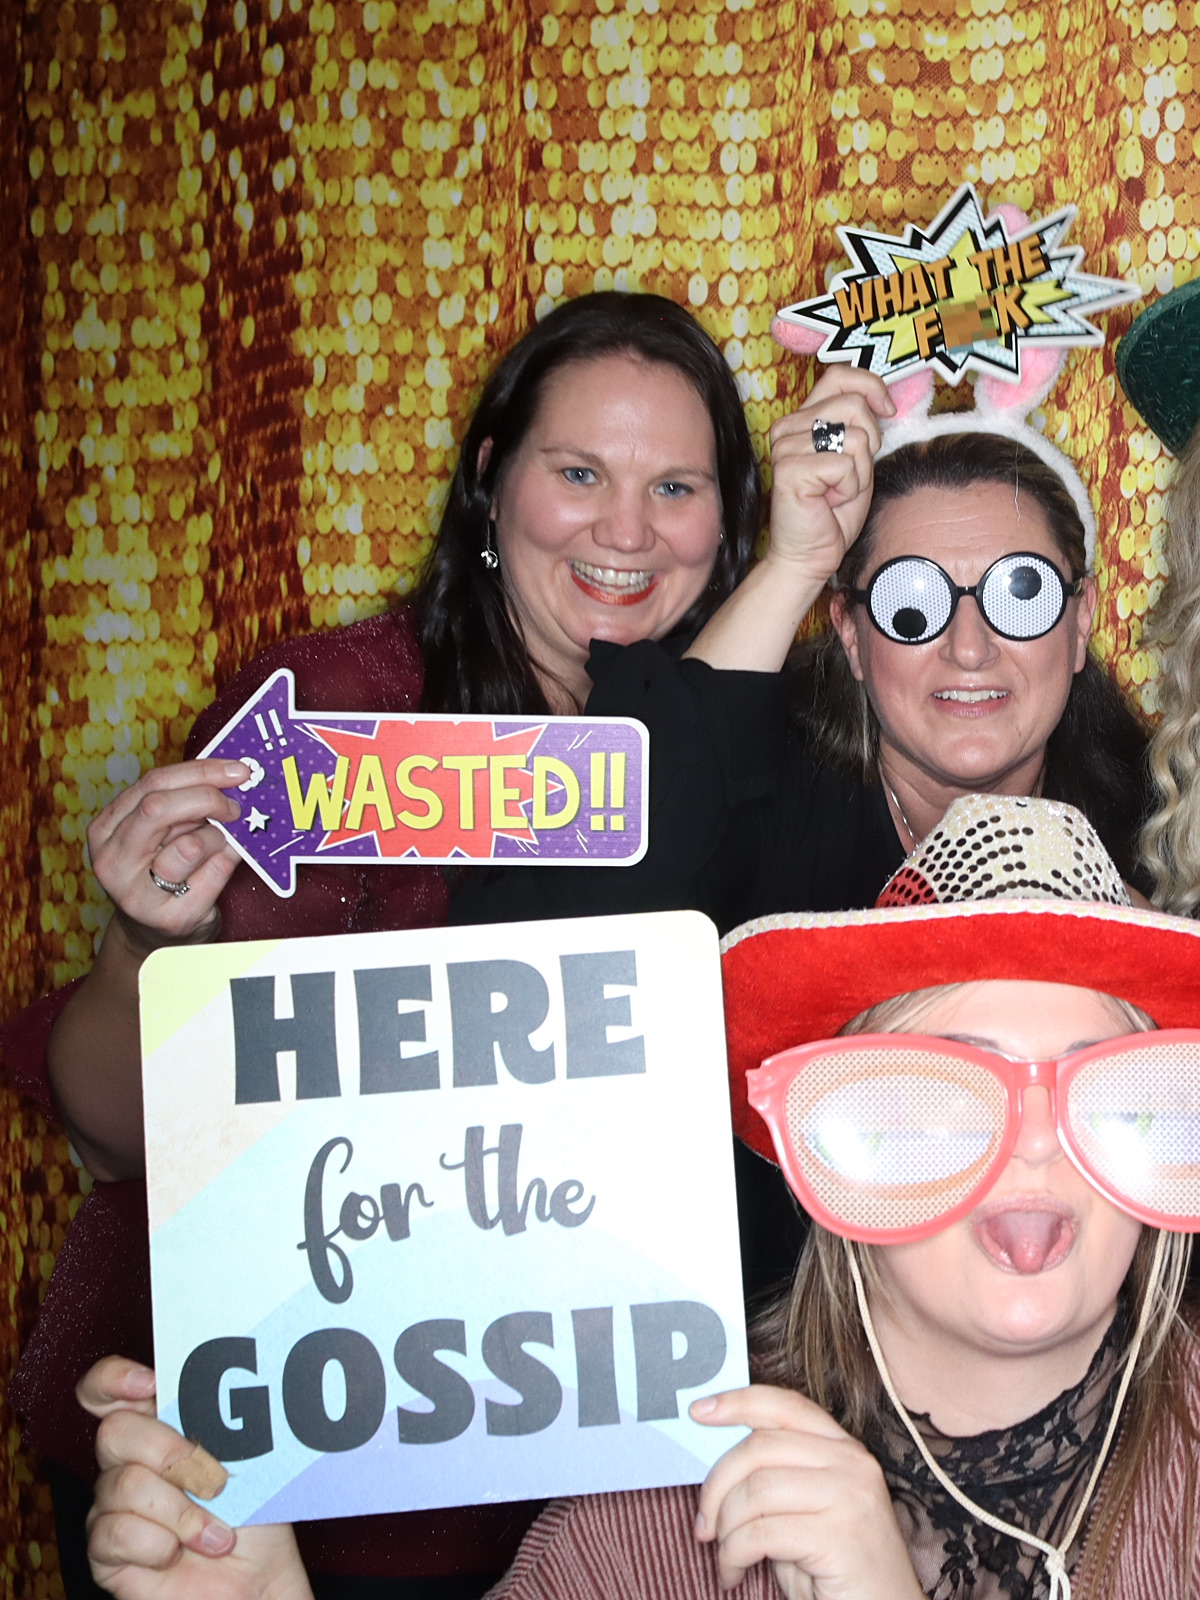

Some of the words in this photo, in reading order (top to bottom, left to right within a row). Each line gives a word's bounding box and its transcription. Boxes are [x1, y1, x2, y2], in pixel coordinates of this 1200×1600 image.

[833, 256, 953, 330] WHAT
[966, 234, 1048, 291] THE
[912, 285, 1031, 359] FK
[281, 752, 627, 832] WASTED!!
[228, 949, 647, 1106] HERE
[296, 1135, 435, 1305] for
[438, 1122, 597, 1238] the
[176, 1299, 728, 1464] GOSSIP
